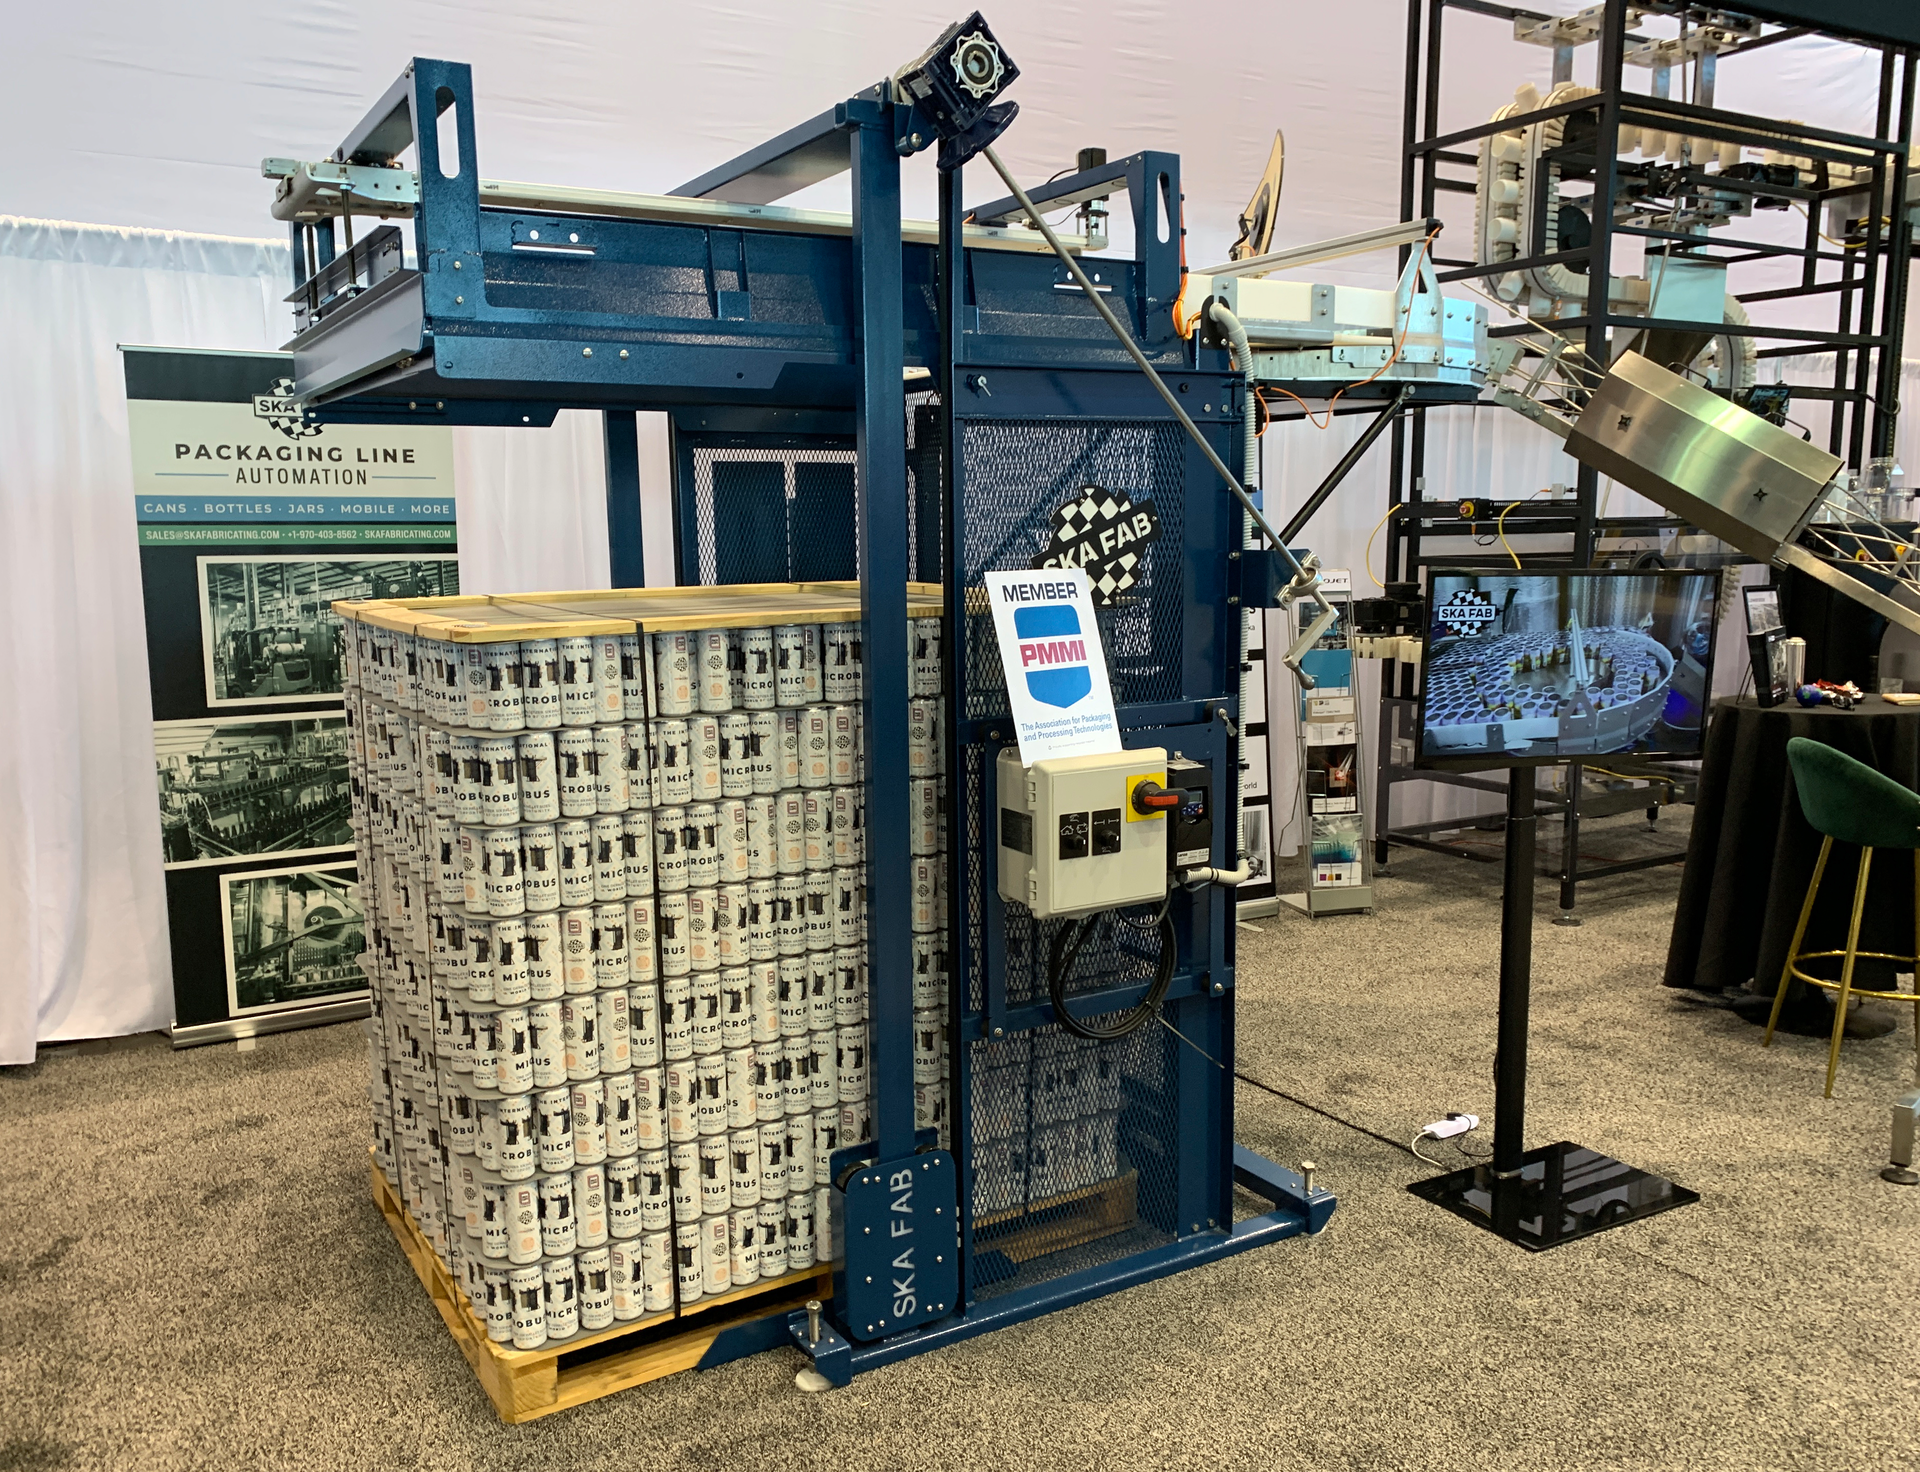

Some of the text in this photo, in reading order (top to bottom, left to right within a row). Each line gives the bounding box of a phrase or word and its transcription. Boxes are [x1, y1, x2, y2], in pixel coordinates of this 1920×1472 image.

[175, 444, 416, 464] PACKAGING LINE
[236, 467, 367, 485] AUTOMATION
[143, 503, 450, 515] CANS BOTTLES JARS MOBILE MORE
[145, 530, 280, 541] SALES@SKAFABRICATING.COM
[364, 529, 451, 540] SKAFABRICATING.COM
[1098, 511, 1153, 556] FAB
[1002, 582, 1079, 602] MEMBER
[1441, 608, 1493, 619] SKA FAB
[1019, 639, 1088, 668] PMMI
[1021, 712, 1112, 732] The Association for Packaging
[1023, 721, 1113, 742] and Processing Technologies
[889, 1168, 917, 1318] SKA FAB
